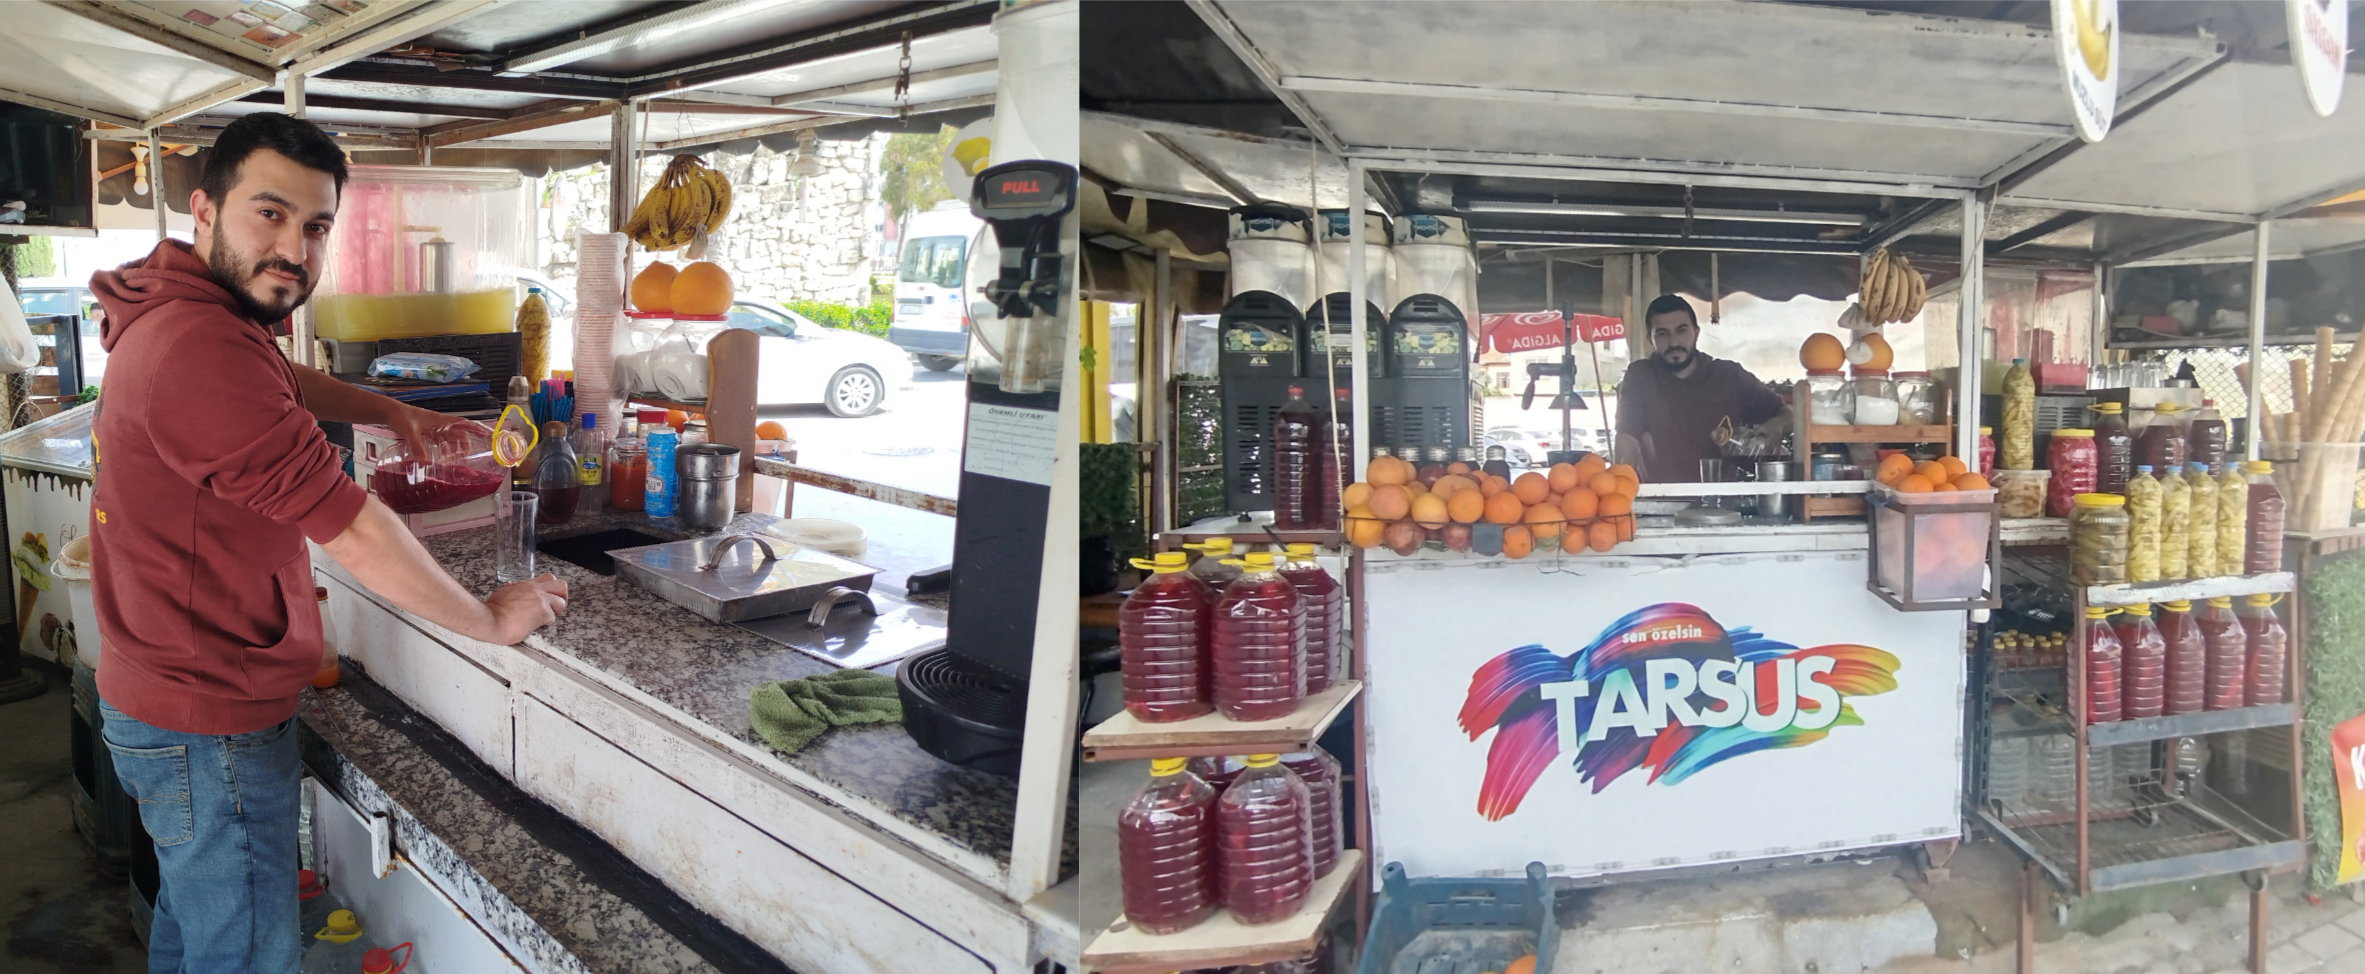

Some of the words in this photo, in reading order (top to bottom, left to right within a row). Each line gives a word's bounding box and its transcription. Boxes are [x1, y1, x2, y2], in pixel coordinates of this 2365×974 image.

[1001, 180, 1040, 194] PULL
[1622, 631, 1647, 644] sen
[1651, 624, 1702, 641] özelsin
